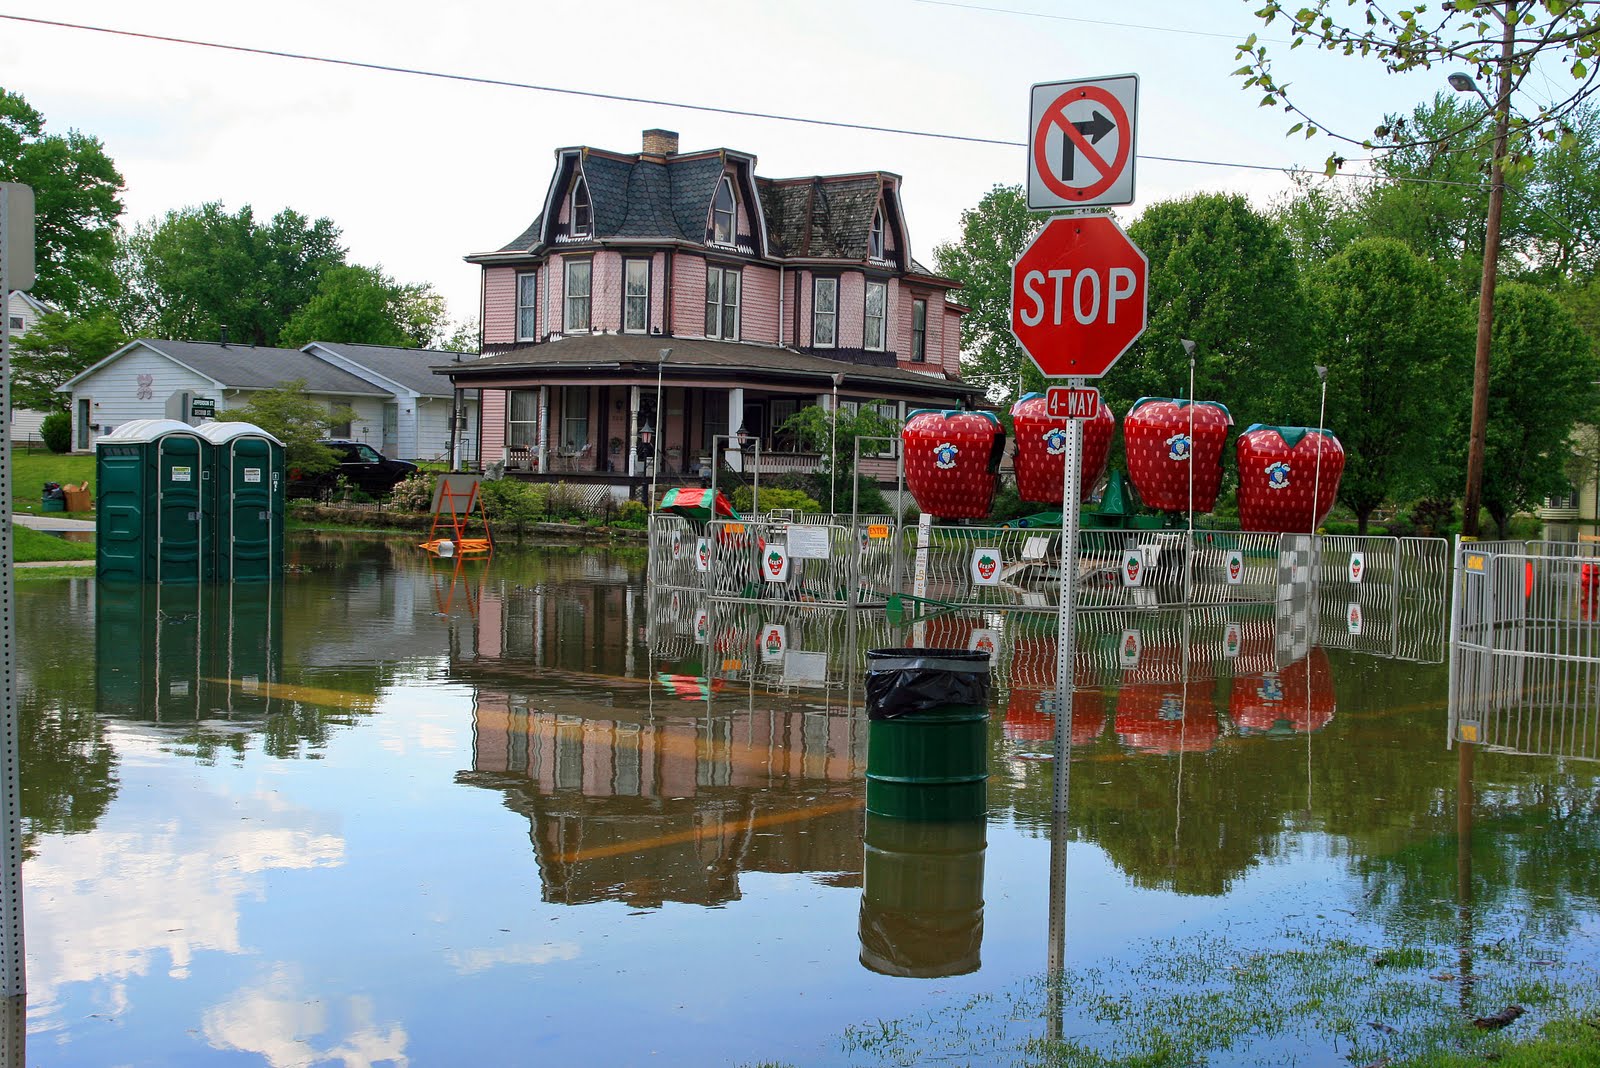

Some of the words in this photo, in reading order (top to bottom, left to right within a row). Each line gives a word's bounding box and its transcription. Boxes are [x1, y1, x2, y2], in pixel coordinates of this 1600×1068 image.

[1020, 267, 1137, 327] STOP
[1050, 391, 1095, 415] 4-WAY
[869, 527, 887, 535] ENTER
